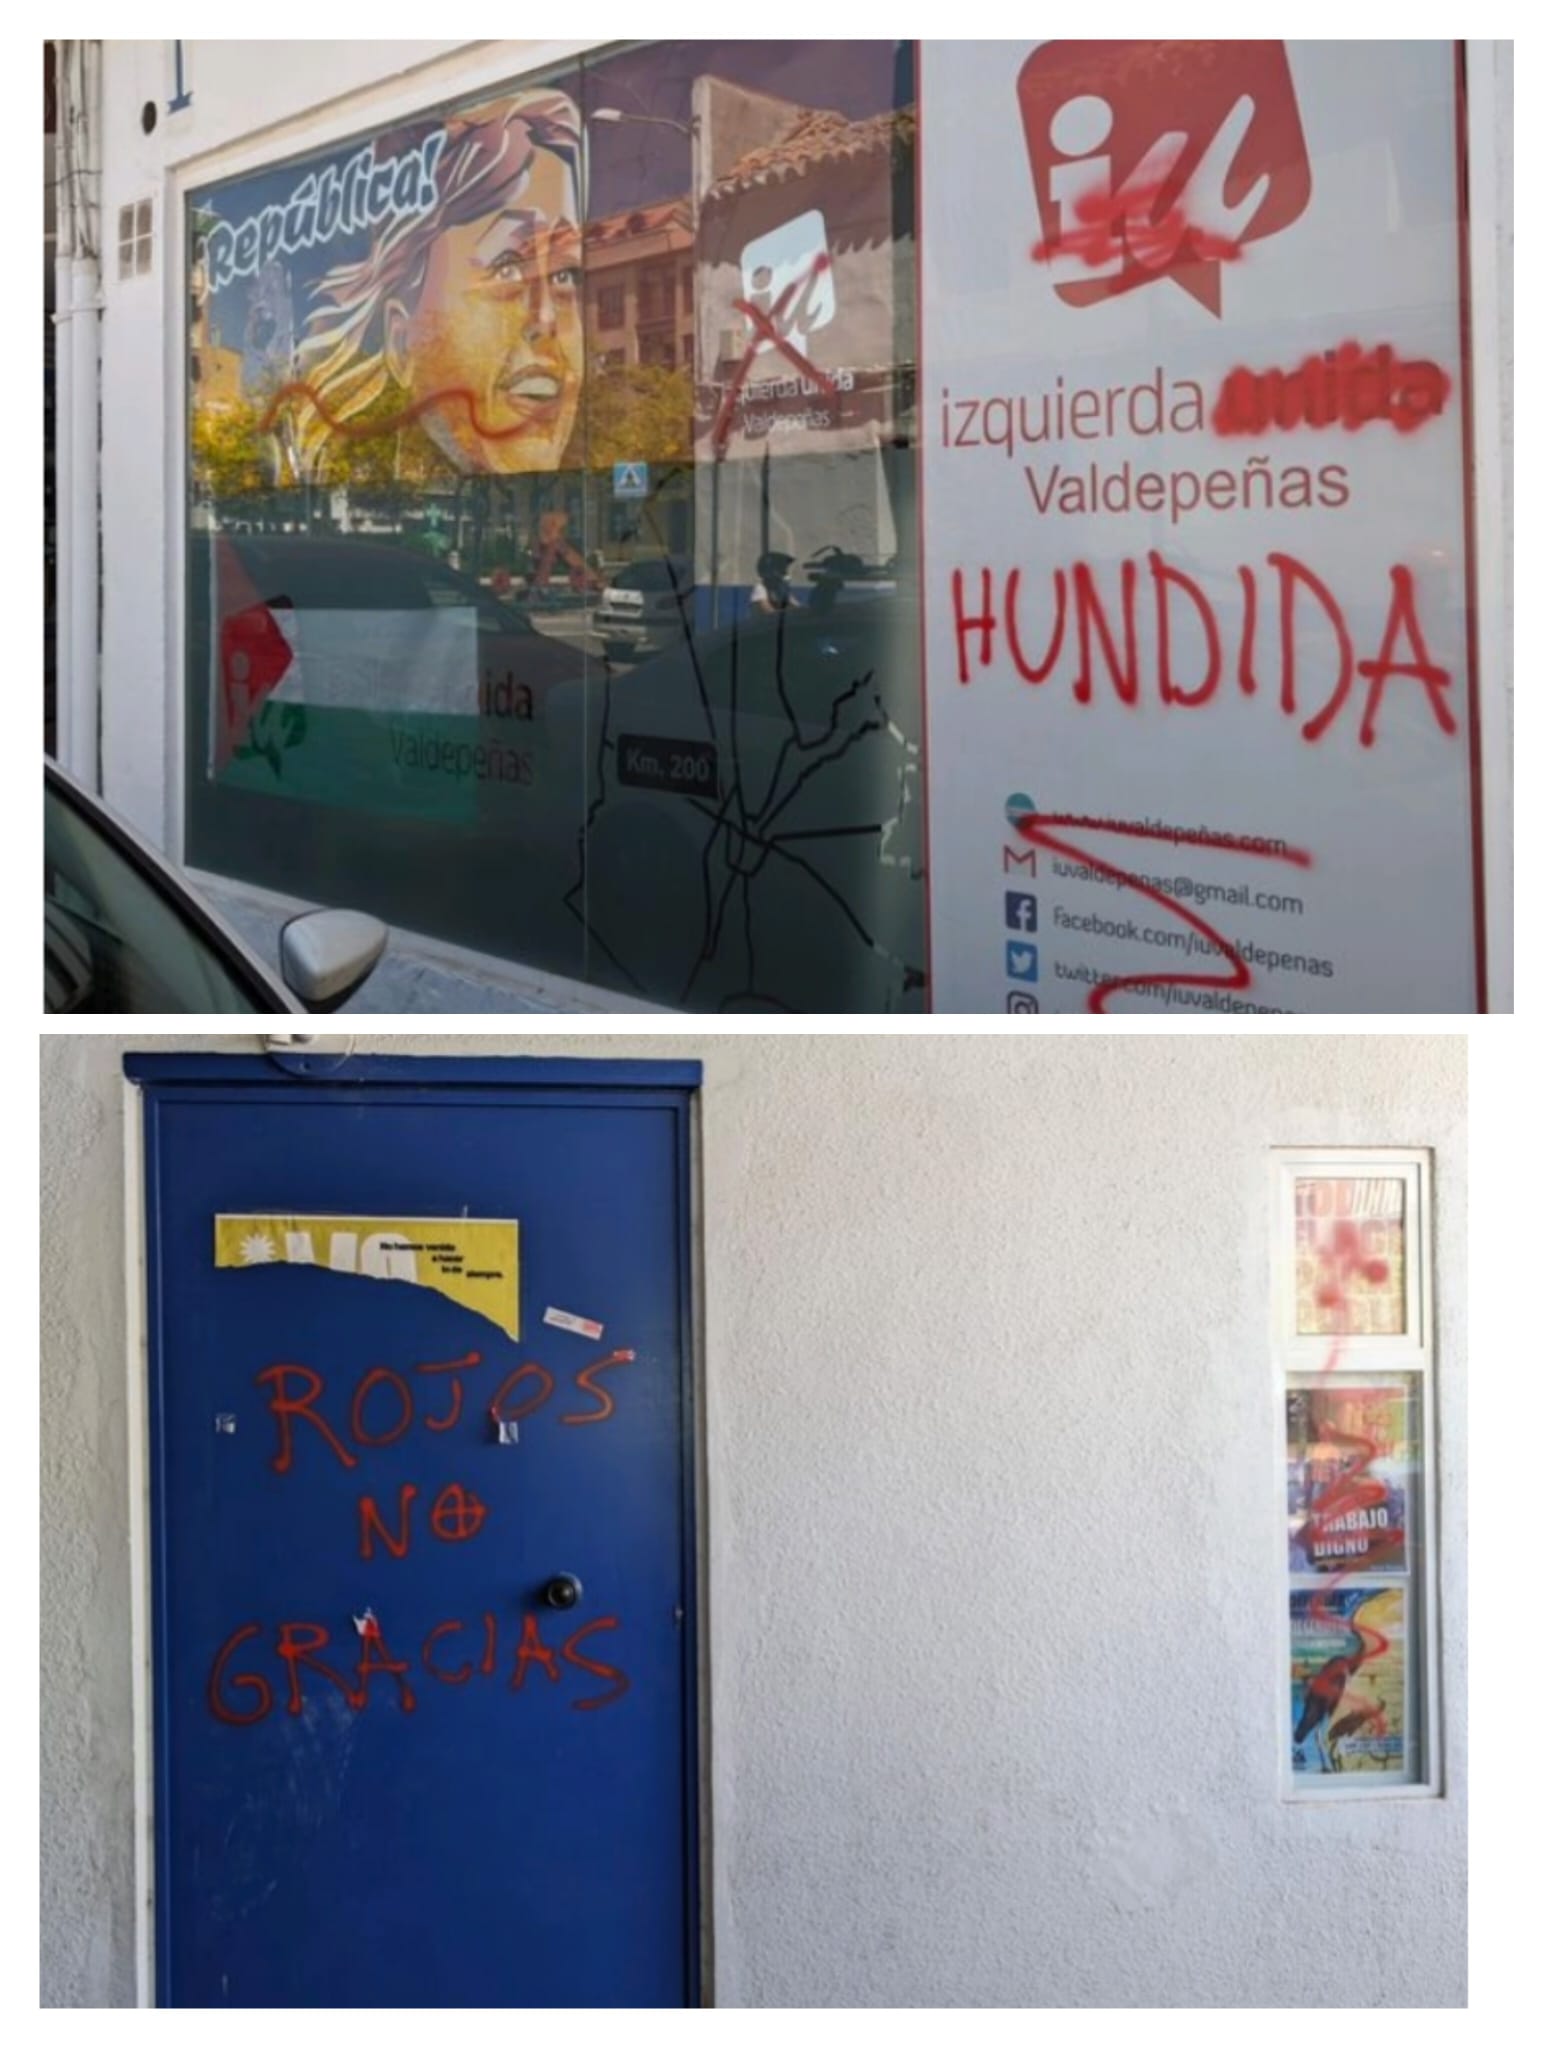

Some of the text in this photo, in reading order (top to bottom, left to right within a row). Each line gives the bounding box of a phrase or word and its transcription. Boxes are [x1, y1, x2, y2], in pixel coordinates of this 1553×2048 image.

[205, 128, 447, 293] República!
[940, 367, 1204, 458] izquierda
[1024, 456, 1351, 525] Valdepeñas
[951, 549, 1458, 748] HUNDIDA
[478, 668, 533, 721] ida
[669, 753, 711, 783] 200
[1053, 860, 1304, 915] iuvaldepenas@gmail.com
[1053, 905, 1334, 978] Facebook.com/iuvaldepenas
[256, 1350, 634, 1473] ROJOS
[208, 1610, 631, 1726] GRACIAS
